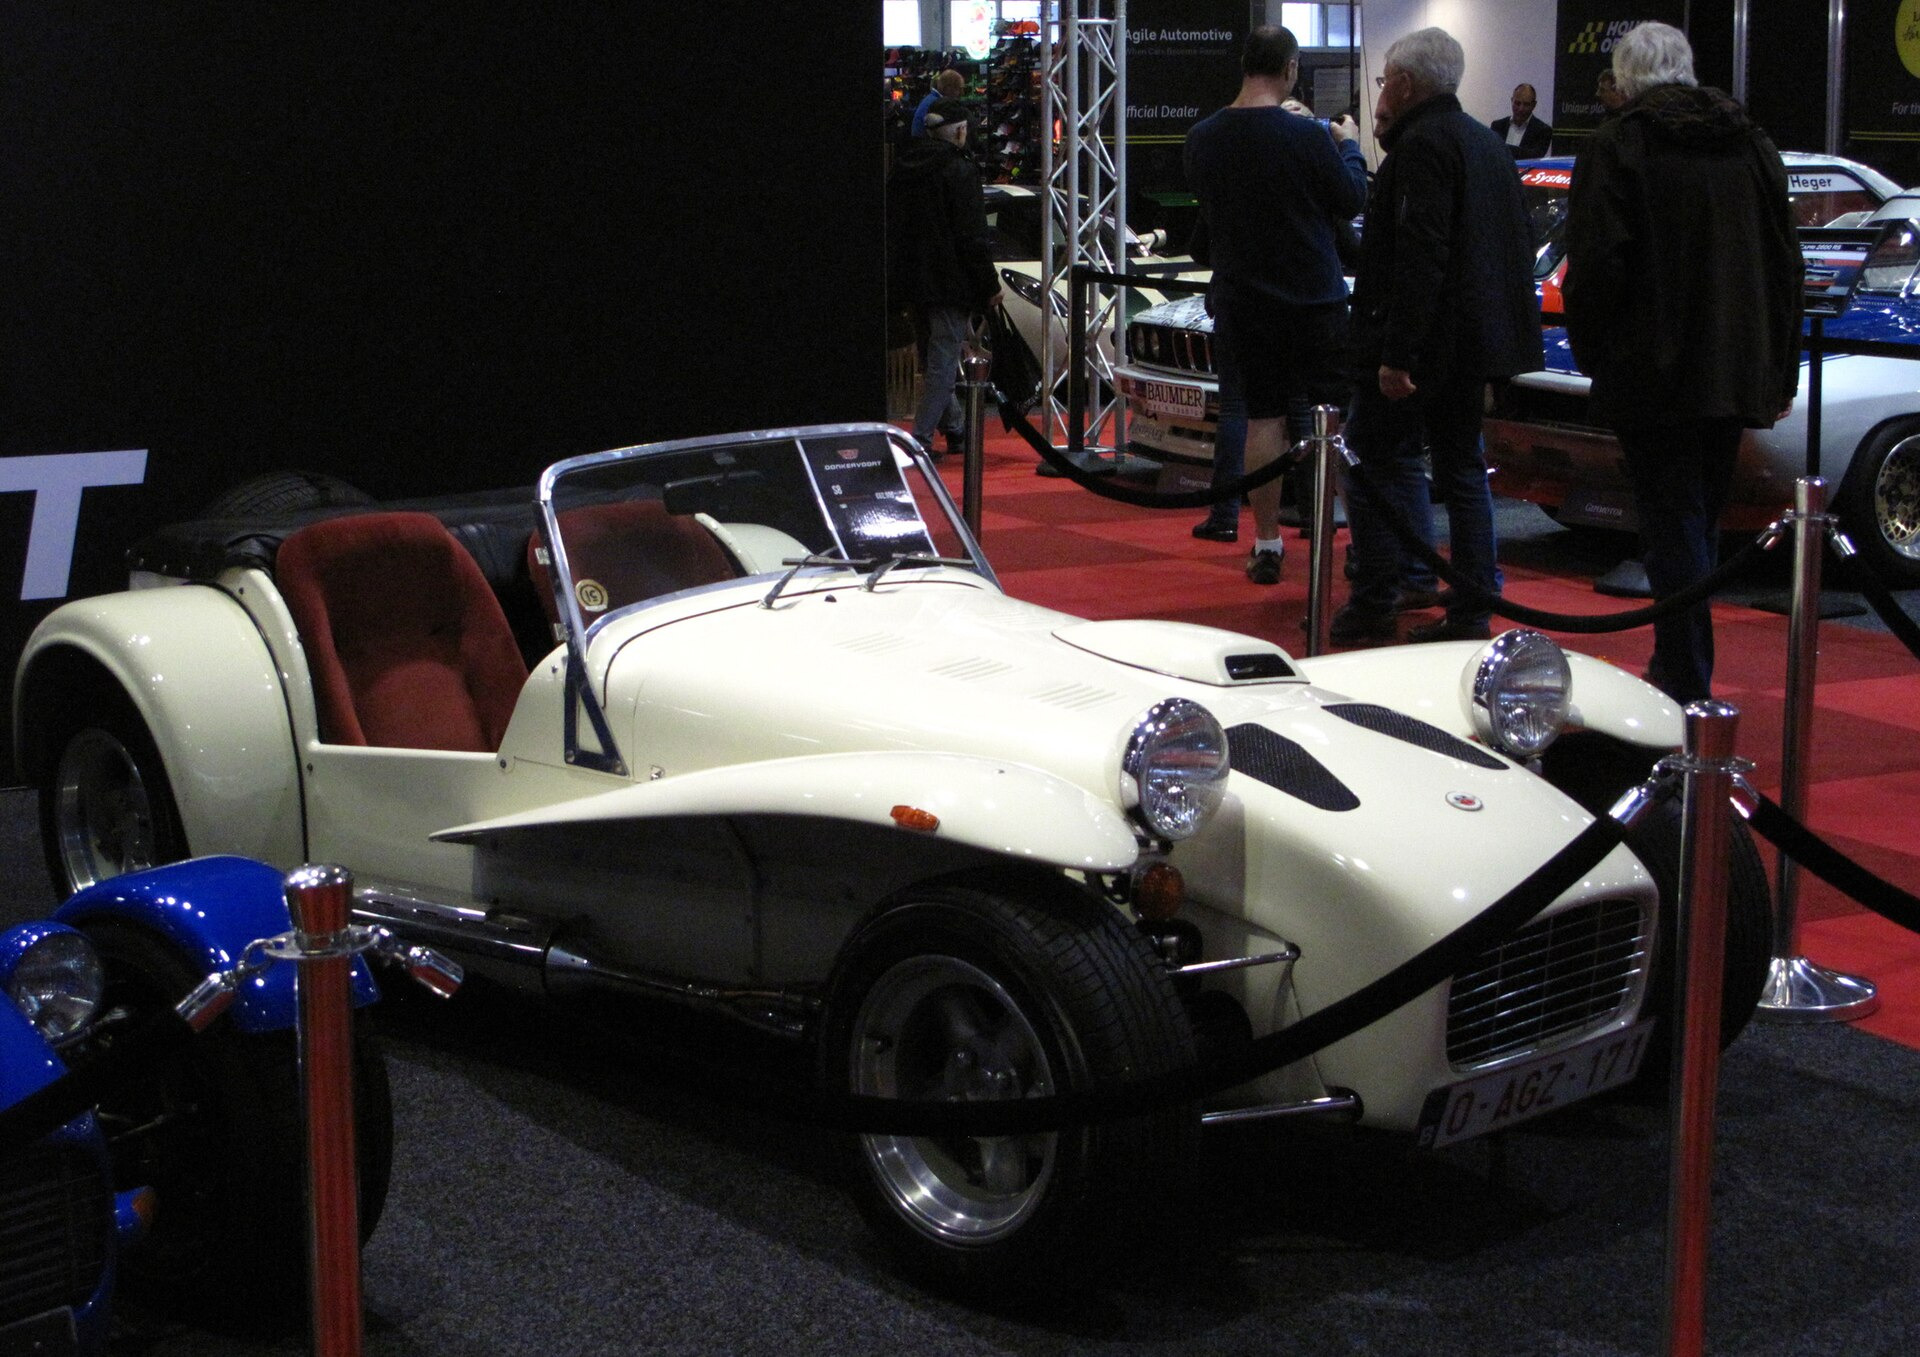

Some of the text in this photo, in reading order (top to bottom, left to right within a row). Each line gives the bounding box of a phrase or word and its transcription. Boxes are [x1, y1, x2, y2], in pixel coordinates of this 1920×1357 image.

[1159, 28, 1233, 41] Automotive
[1126, 104, 1199, 118] fficial Dealer
[1892, 102, 1909, 114] For
[1790, 175, 1832, 190] Heger
[0, 449, 148, 600] T
